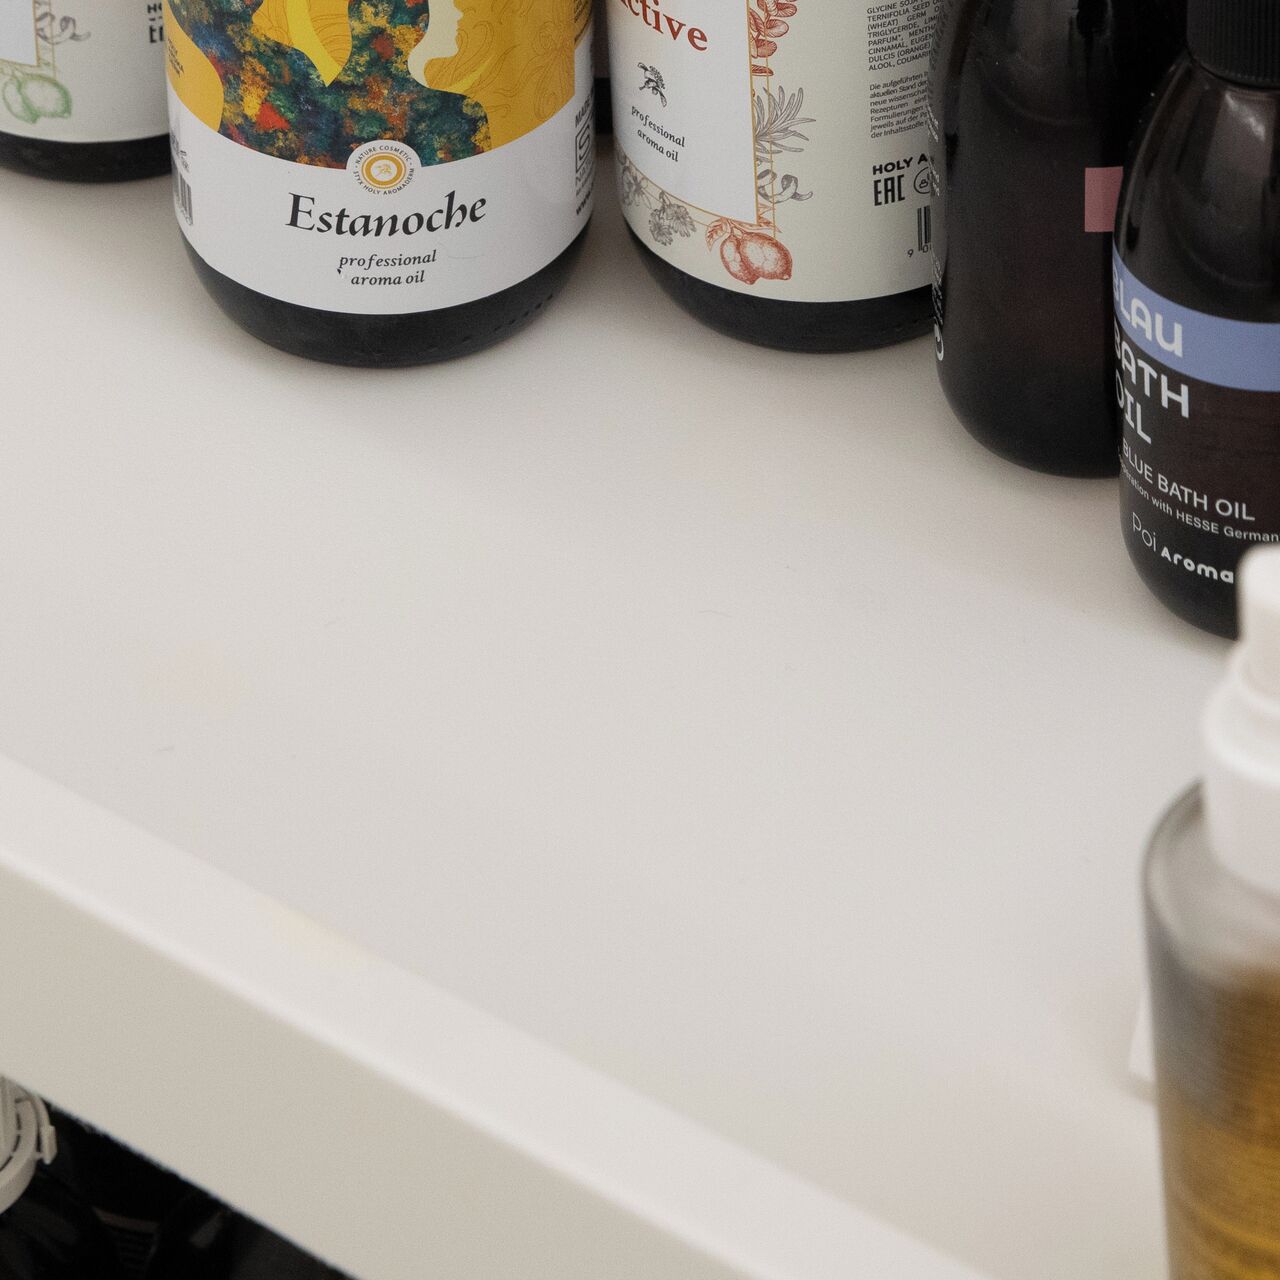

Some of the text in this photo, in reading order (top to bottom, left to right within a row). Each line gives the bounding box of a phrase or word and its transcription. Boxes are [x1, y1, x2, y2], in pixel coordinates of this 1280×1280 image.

[867, 2, 897, 14] GLYCINE
[867, 8, 909, 22] TERNIFOLIA
[912, 1, 930, 12] SEED
[868, 11, 927, 31] (WHEAT) GERM
[869, 52, 895, 63] DULCIS
[897, 50, 931, 65] COUMARI
[632, 106, 685, 147] professional
[355, 145, 412, 164] NATURE COSMETIC
[638, 129, 678, 162] aroma oil
[873, 157, 913, 175] HOLY
[363, 185, 380, 194] HOLY
[383, 168, 414, 195] AROMADERM
[874, 174, 905, 206] EAC
[285, 190, 487, 237] Estanoche
[338, 249, 437, 269] professional
[350, 271, 425, 286] aroma oil
[1114, 317, 1189, 418] BATH
[1116, 369, 1151, 445] OIL
[1123, 438, 1255, 521] BLUE BATH OIL
[1152, 496, 1172, 516] with
[1176, 509, 1219, 534] HESSE
[1132, 512, 1234, 584] Poi Aroma
